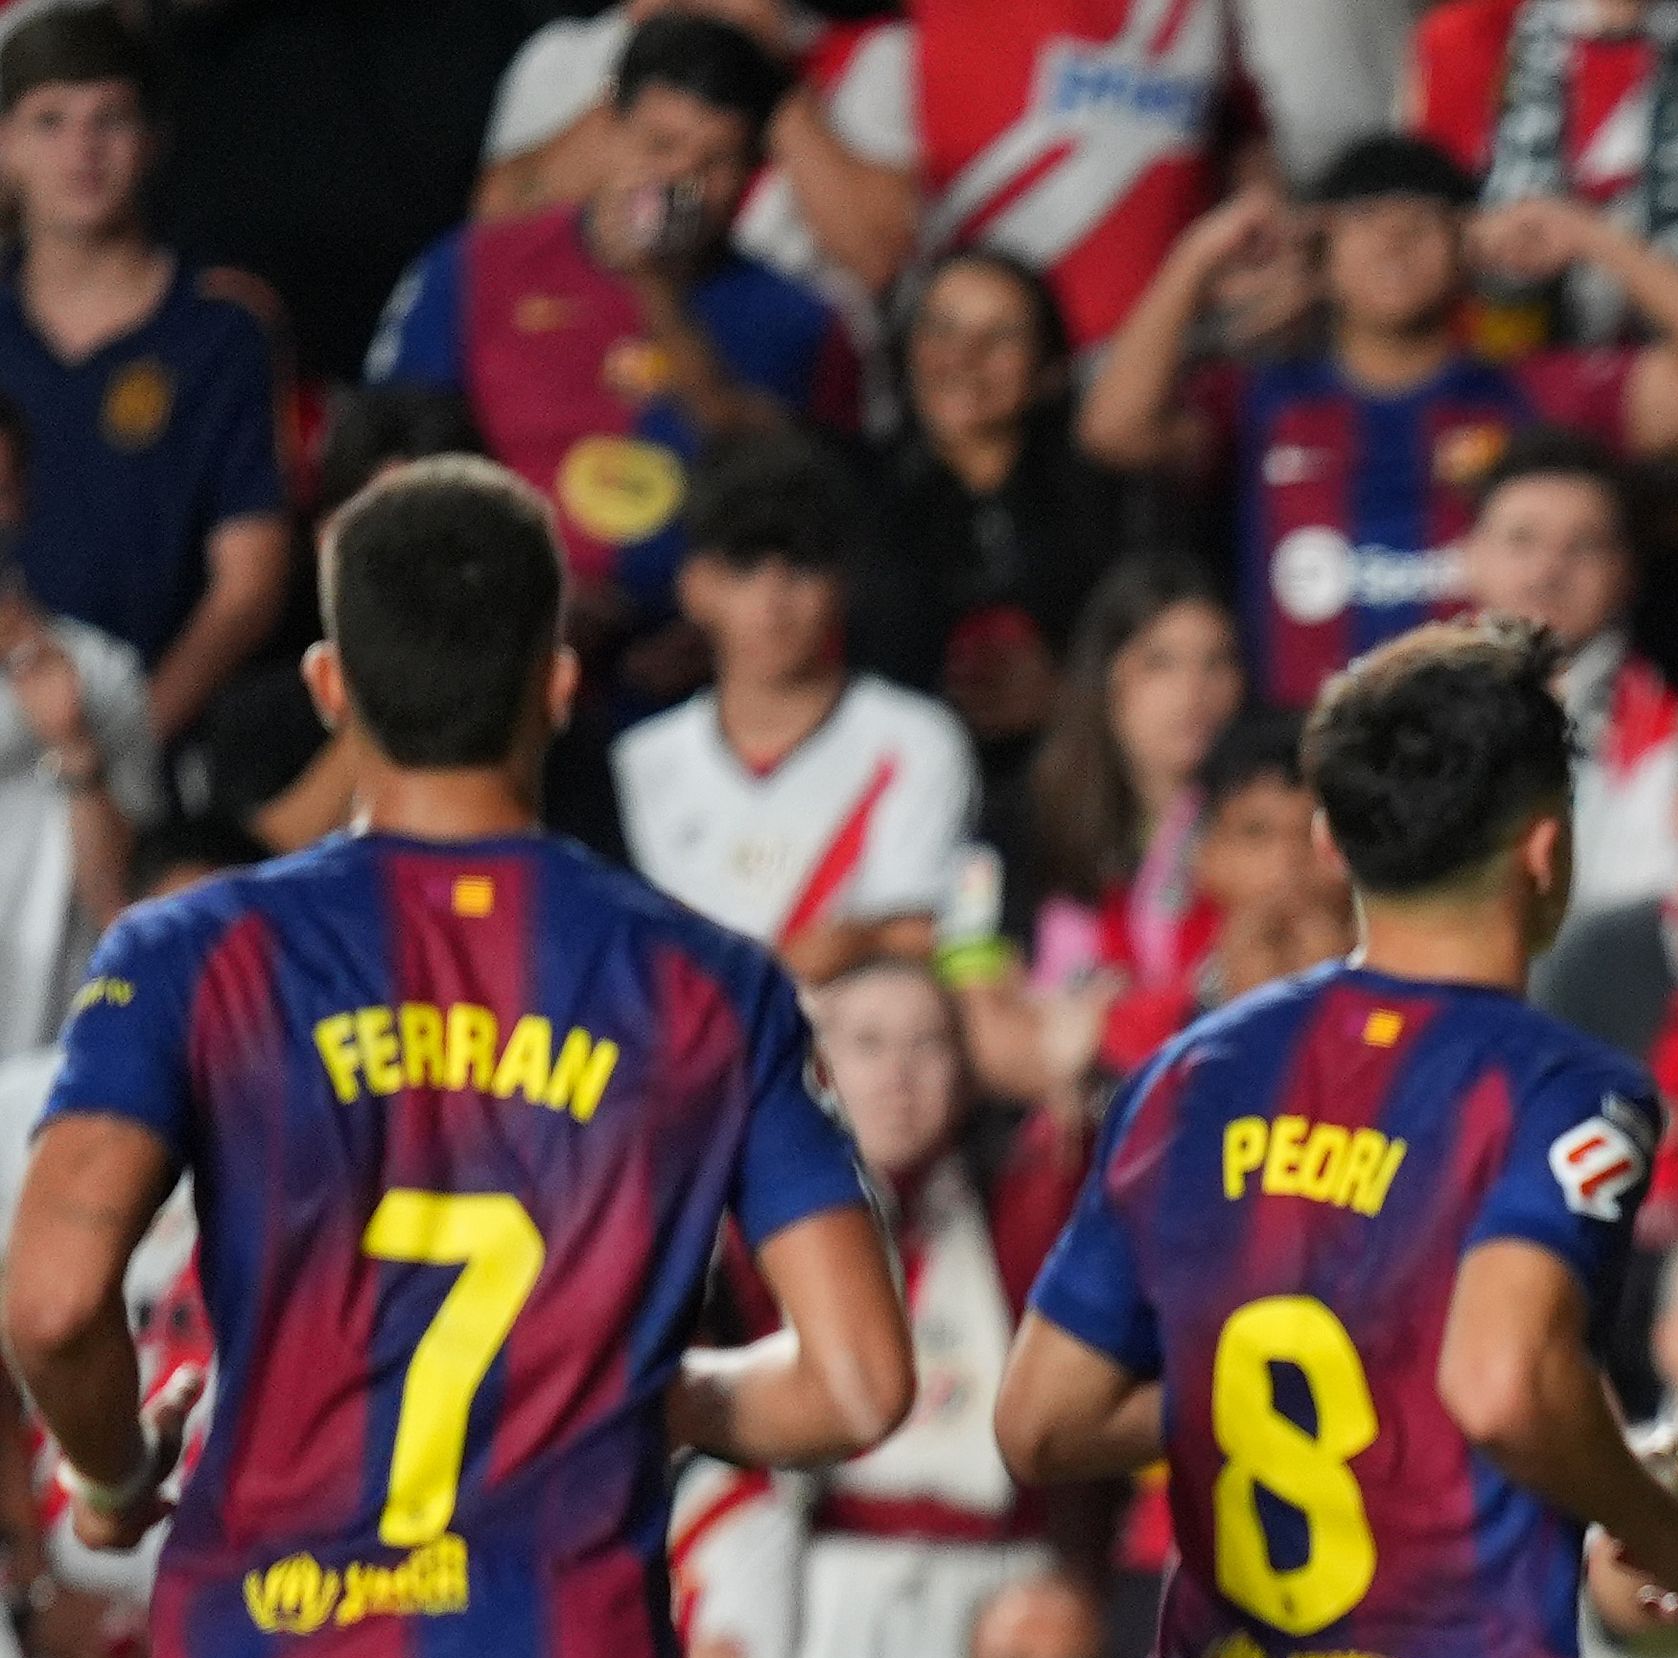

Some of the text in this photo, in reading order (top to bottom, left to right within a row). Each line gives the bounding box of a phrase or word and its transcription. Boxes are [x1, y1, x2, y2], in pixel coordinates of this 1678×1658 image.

[314, 1004, 619, 1122] FERRAN
[1222, 1115, 1407, 1217] PEDRI
[363, 1188, 546, 1547] 7
[1212, 1295, 1378, 1636] 8
